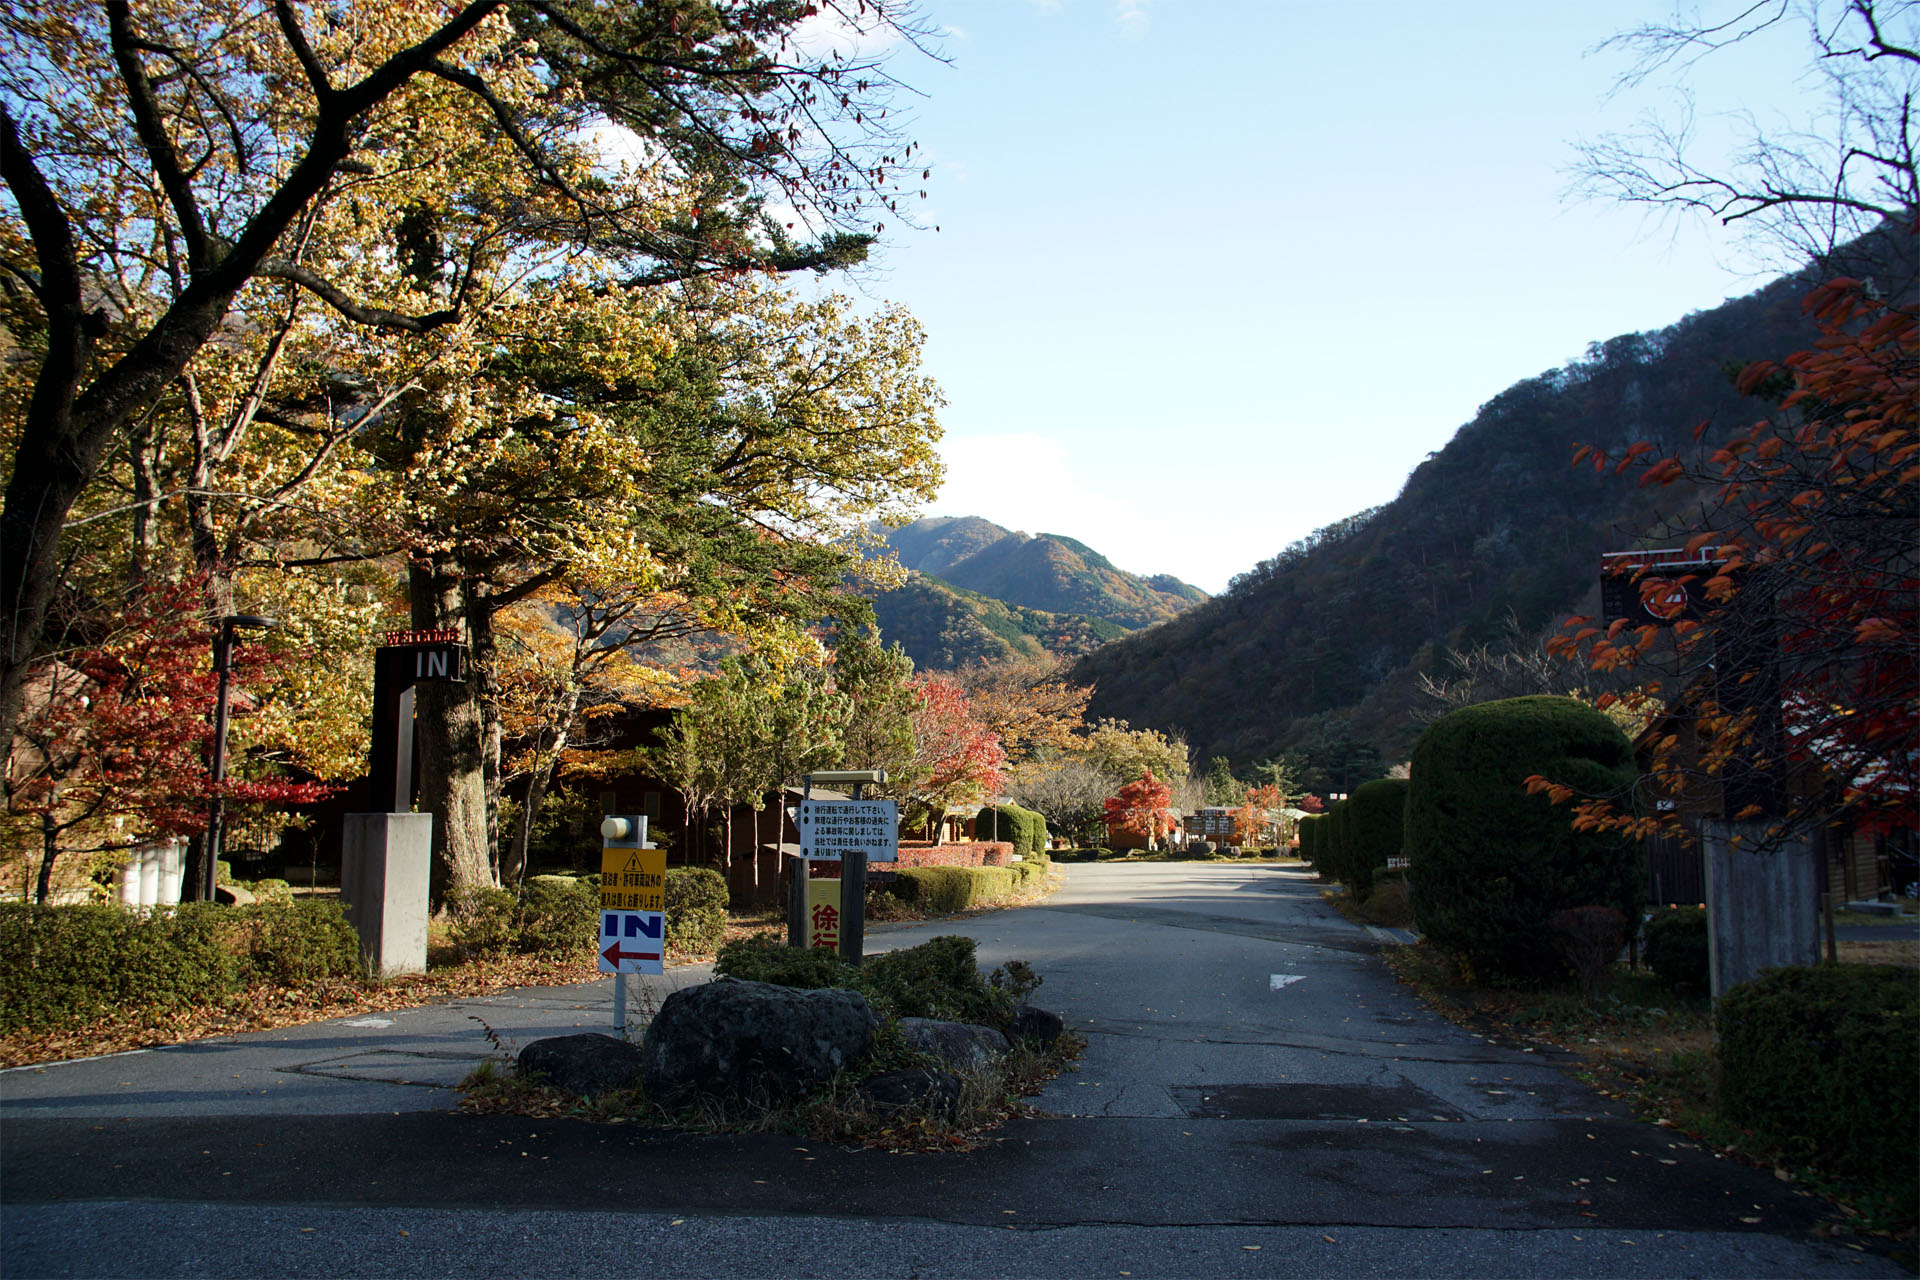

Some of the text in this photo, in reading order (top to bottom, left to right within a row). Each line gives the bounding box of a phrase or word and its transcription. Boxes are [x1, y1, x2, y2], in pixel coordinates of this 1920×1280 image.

[385, 628, 460, 645] WELCOME
[416, 651, 448, 677] IN
[604, 914, 662, 938] IN
